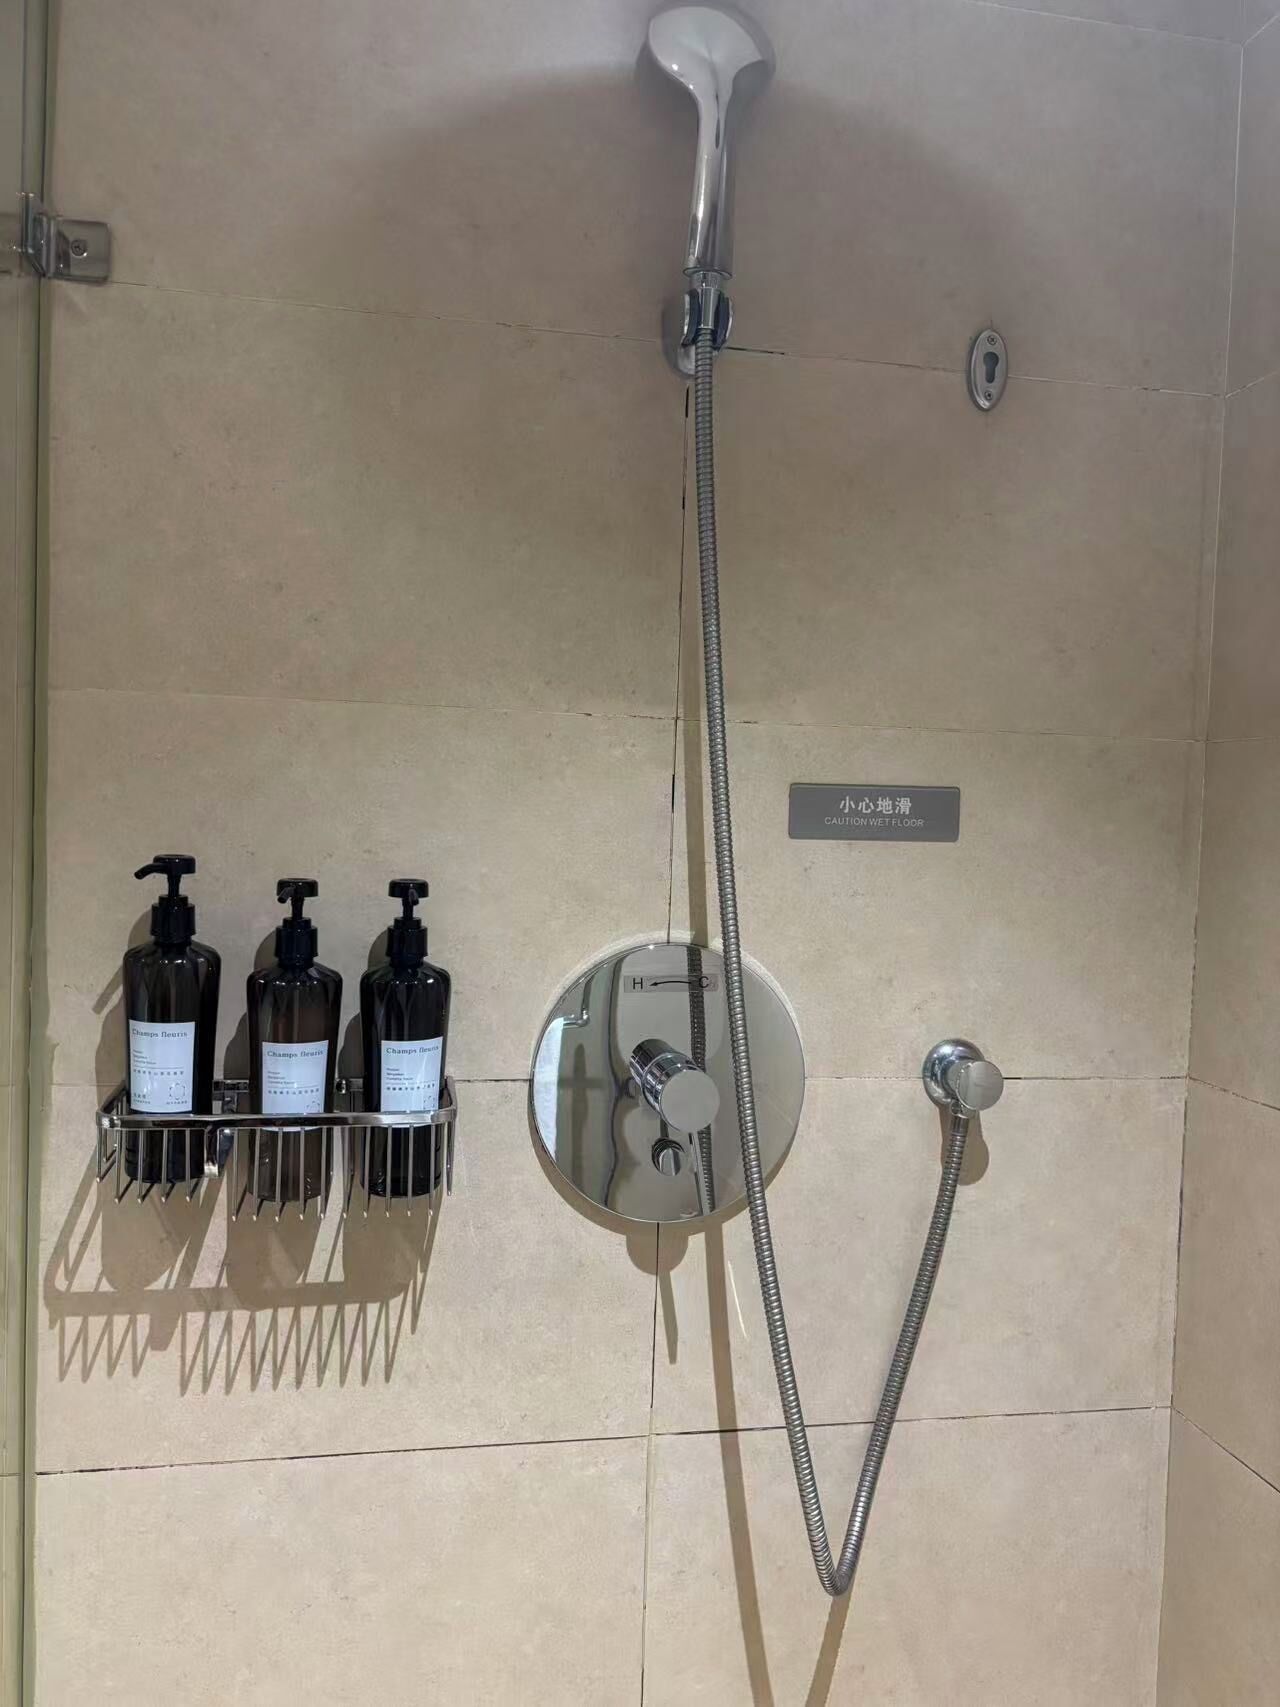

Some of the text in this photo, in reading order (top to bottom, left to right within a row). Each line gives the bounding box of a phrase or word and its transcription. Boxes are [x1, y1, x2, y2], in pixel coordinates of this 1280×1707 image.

[839, 796, 912, 815] 小心地滑
[824, 816, 924, 827] CAUTION WET FLOOR
[632, 977, 643, 990] H
[699, 976, 709, 989] C
[132, 1028, 159, 1038] Champs
[267, 1050, 298, 1059] Champs
[386, 1047, 417, 1055] Champs
